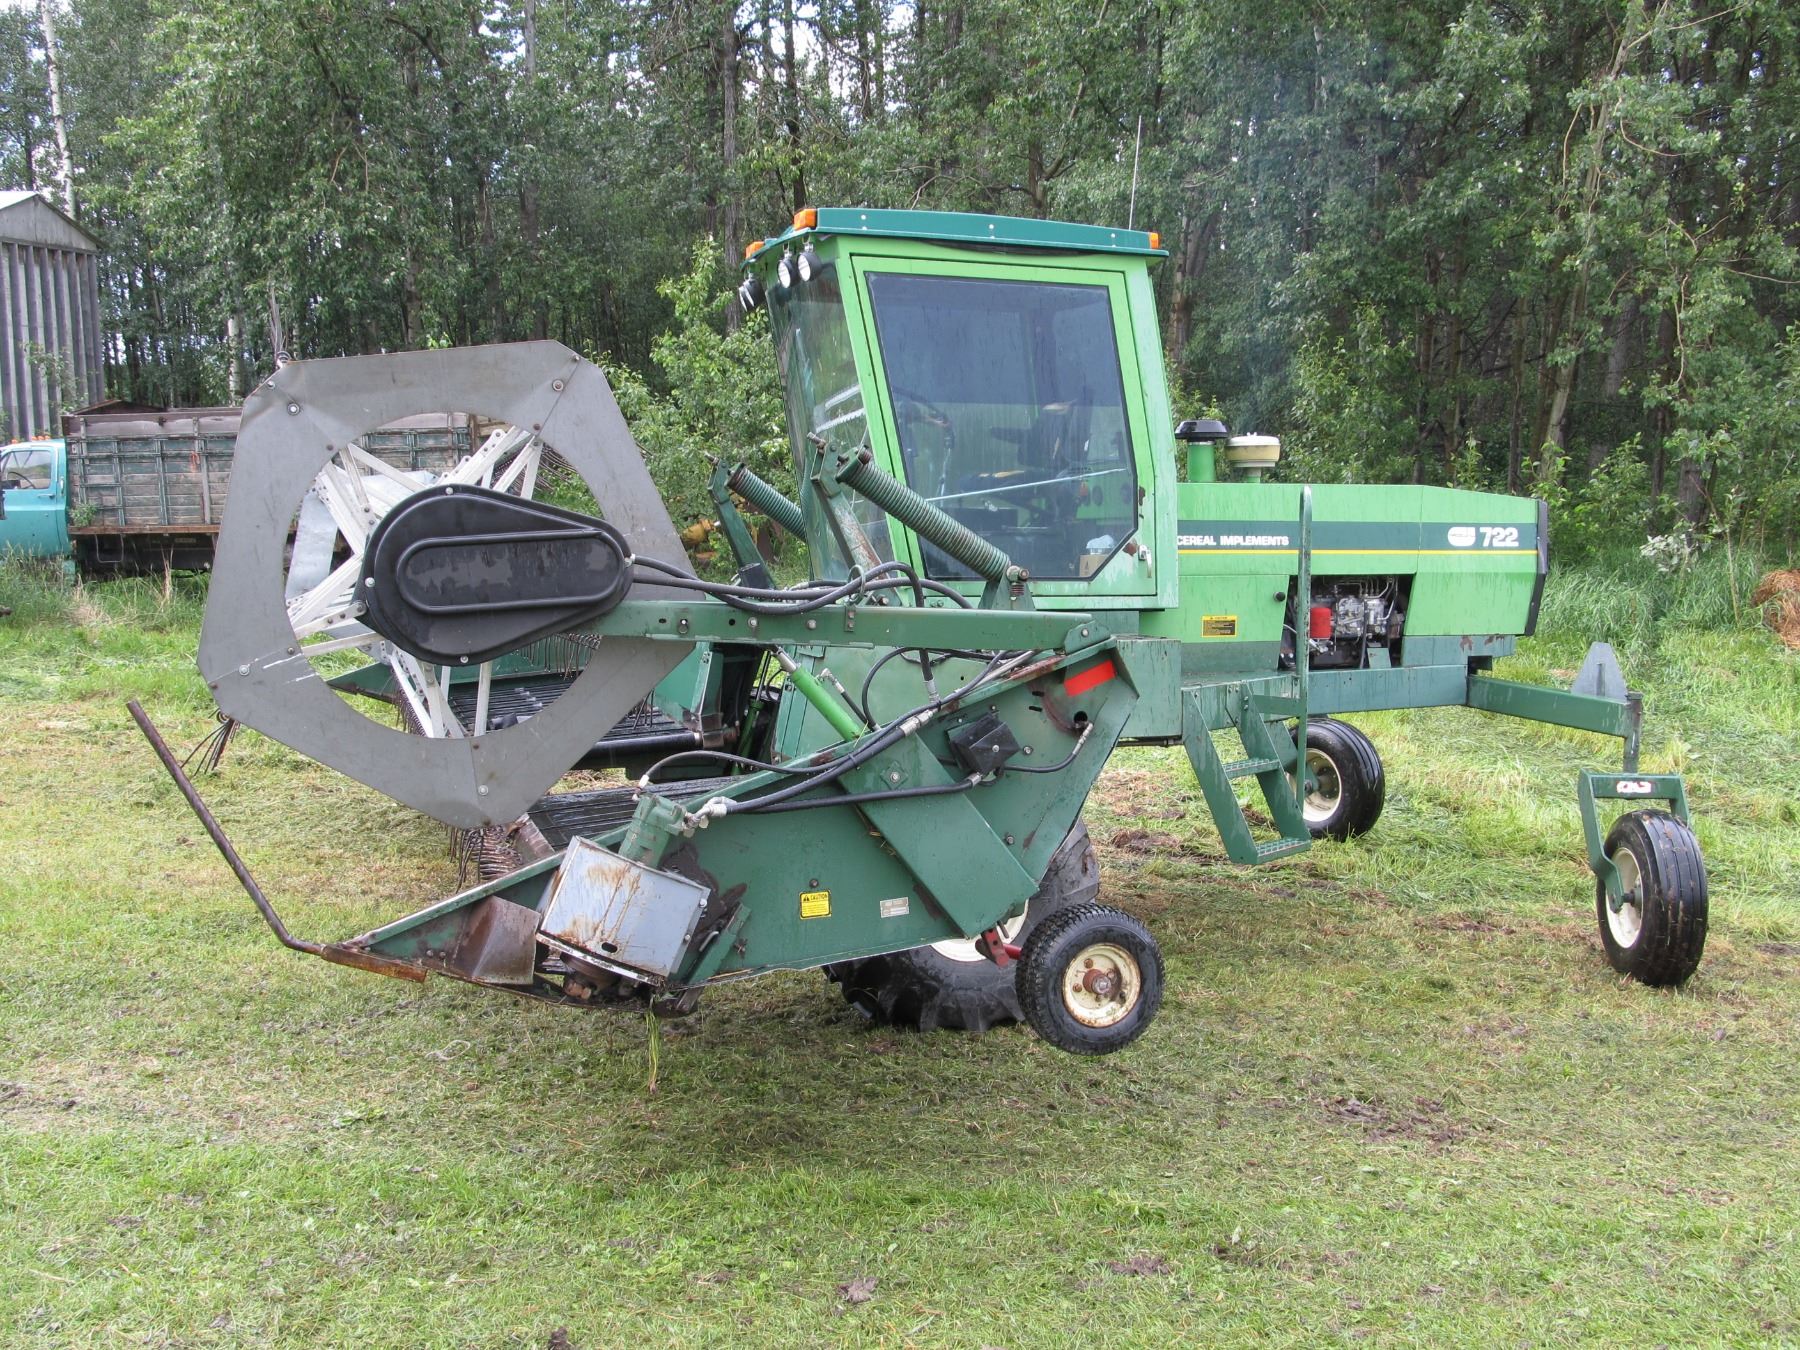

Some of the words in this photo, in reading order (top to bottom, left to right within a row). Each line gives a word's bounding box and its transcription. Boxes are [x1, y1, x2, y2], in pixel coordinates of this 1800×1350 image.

[1176, 535, 1217, 546] CEREAL
[1219, 535, 1290, 546] IMPLEMENTS
[1479, 526, 1519, 547] 722
